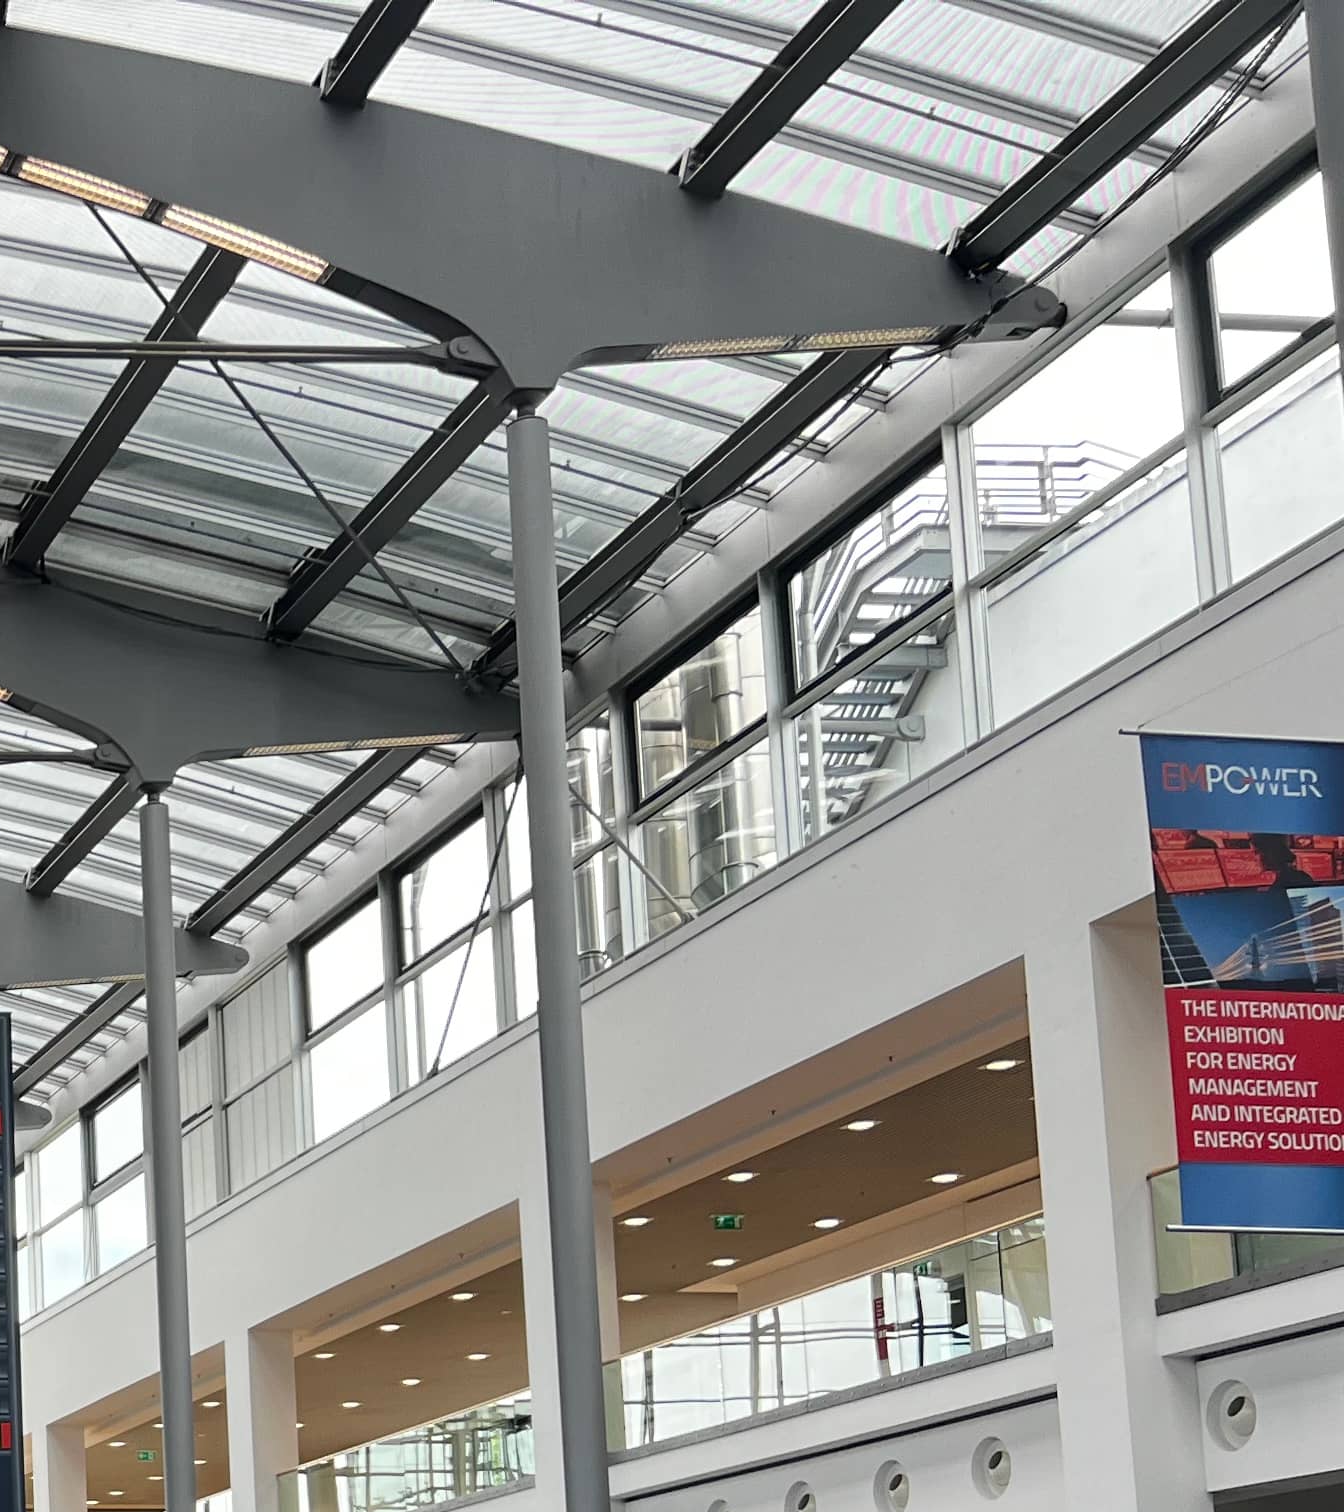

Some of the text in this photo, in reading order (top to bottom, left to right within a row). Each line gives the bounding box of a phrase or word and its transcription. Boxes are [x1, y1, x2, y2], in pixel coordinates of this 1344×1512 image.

[1163, 762, 1323, 798] EMPOWER
[1182, 1000, 1217, 1017] THE
[1184, 1026, 1284, 1045] EXHIBITION
[1186, 1052, 1296, 1071] FOR ENERGY
[1189, 1078, 1318, 1098] MANAGEMENT
[1191, 1104, 1342, 1125] AND INTEGRATED
[1194, 1130, 1344, 1151] ENERGY SOLUTIO
